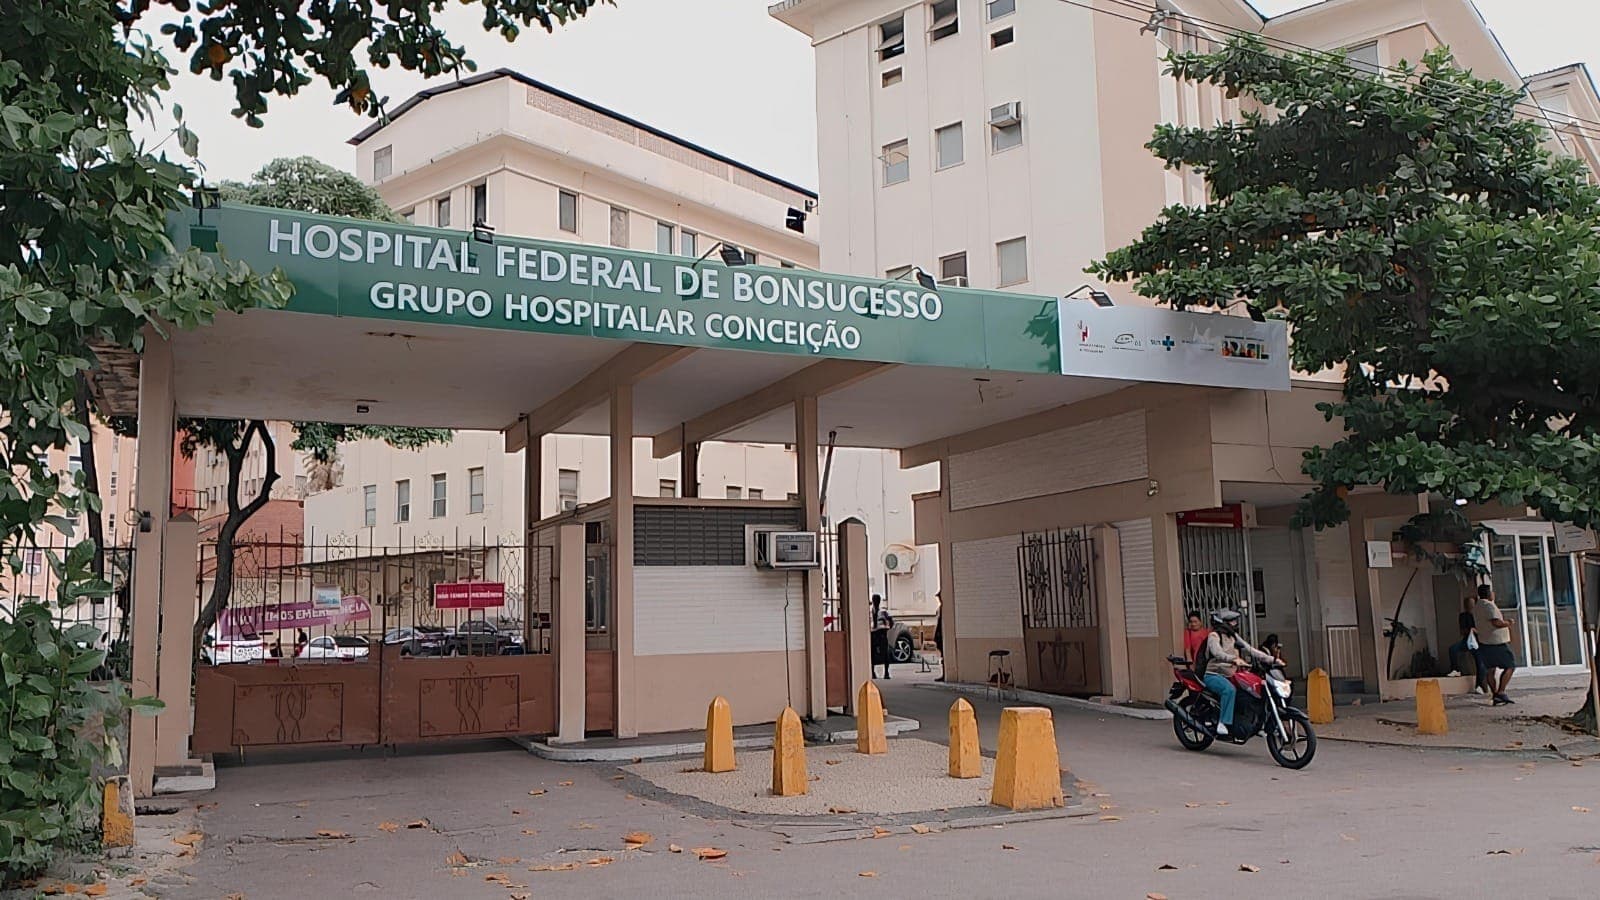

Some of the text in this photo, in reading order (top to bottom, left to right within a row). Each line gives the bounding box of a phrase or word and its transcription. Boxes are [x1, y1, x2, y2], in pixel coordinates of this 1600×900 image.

[268, 218, 943, 322] HOSPITAL FEDERAL DE BONSUCESSO
[370, 281, 861, 354] GRUPO HOSPITALAR CONCEIÇÃO
